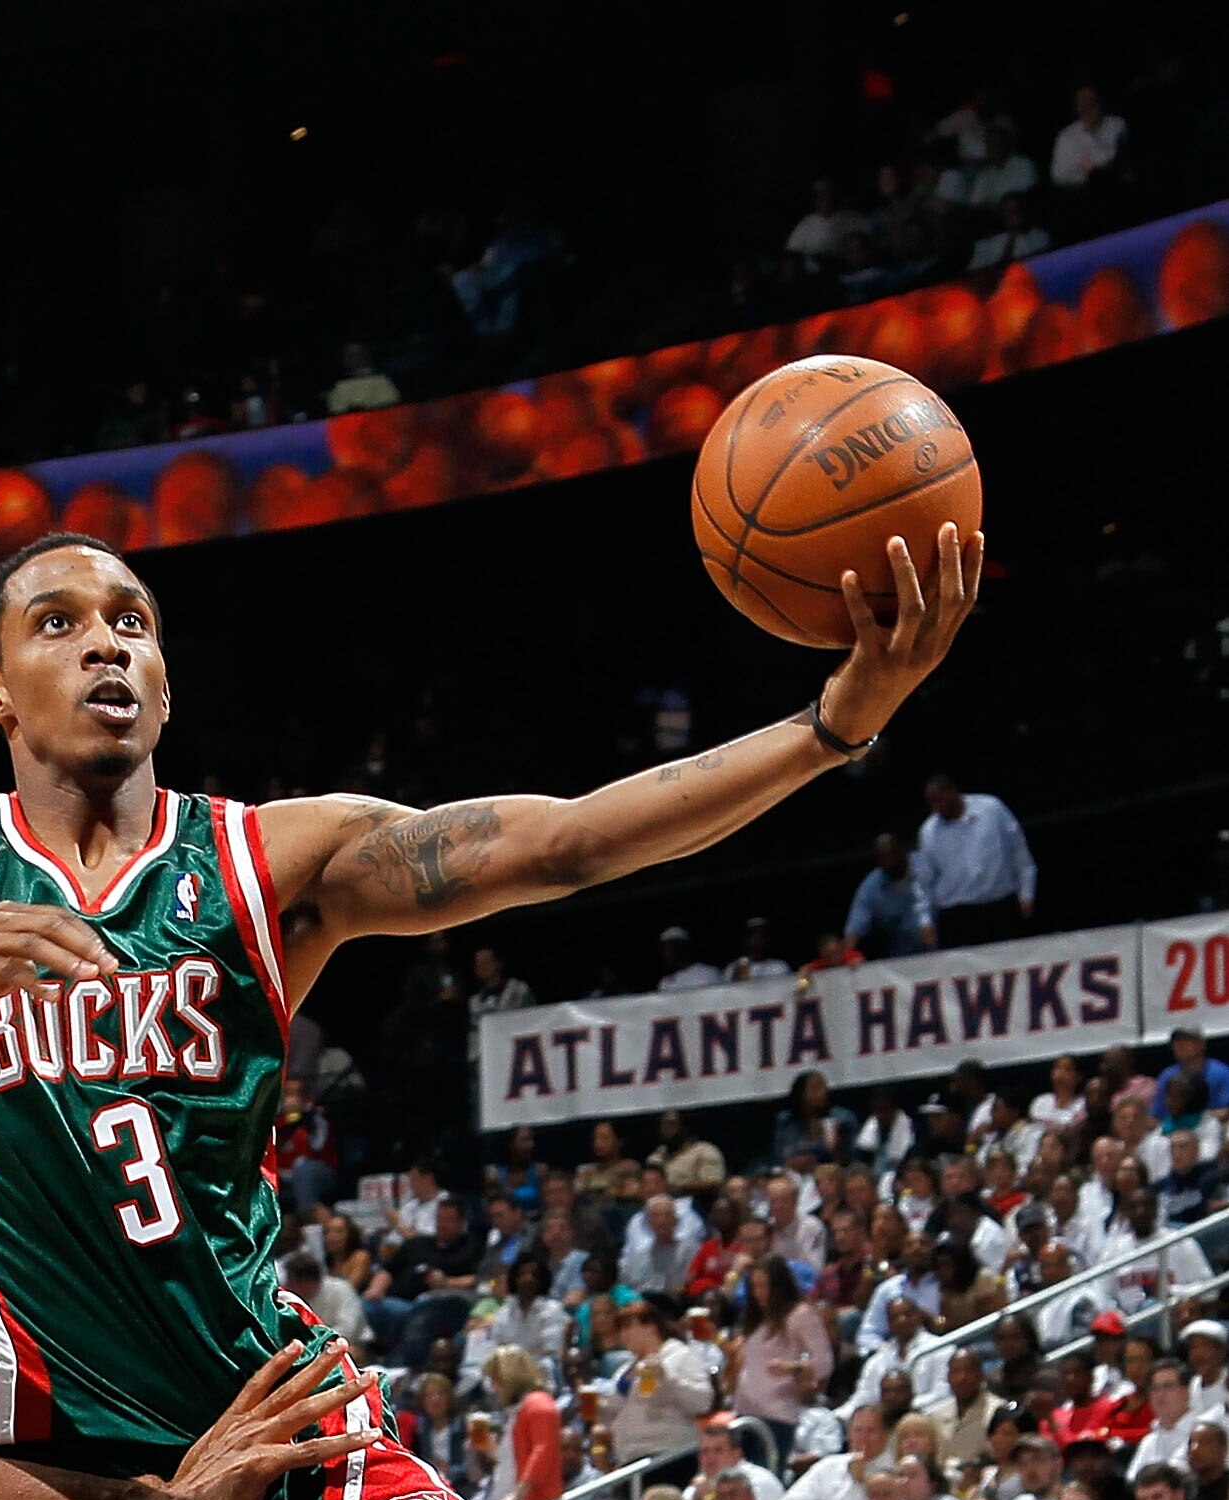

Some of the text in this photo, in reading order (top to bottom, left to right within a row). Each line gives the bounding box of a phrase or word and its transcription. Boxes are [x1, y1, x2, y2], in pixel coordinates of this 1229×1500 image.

[504, 954, 1122, 1101] ATLANTA HAWKS
[89, 1099, 184, 1247] 3
